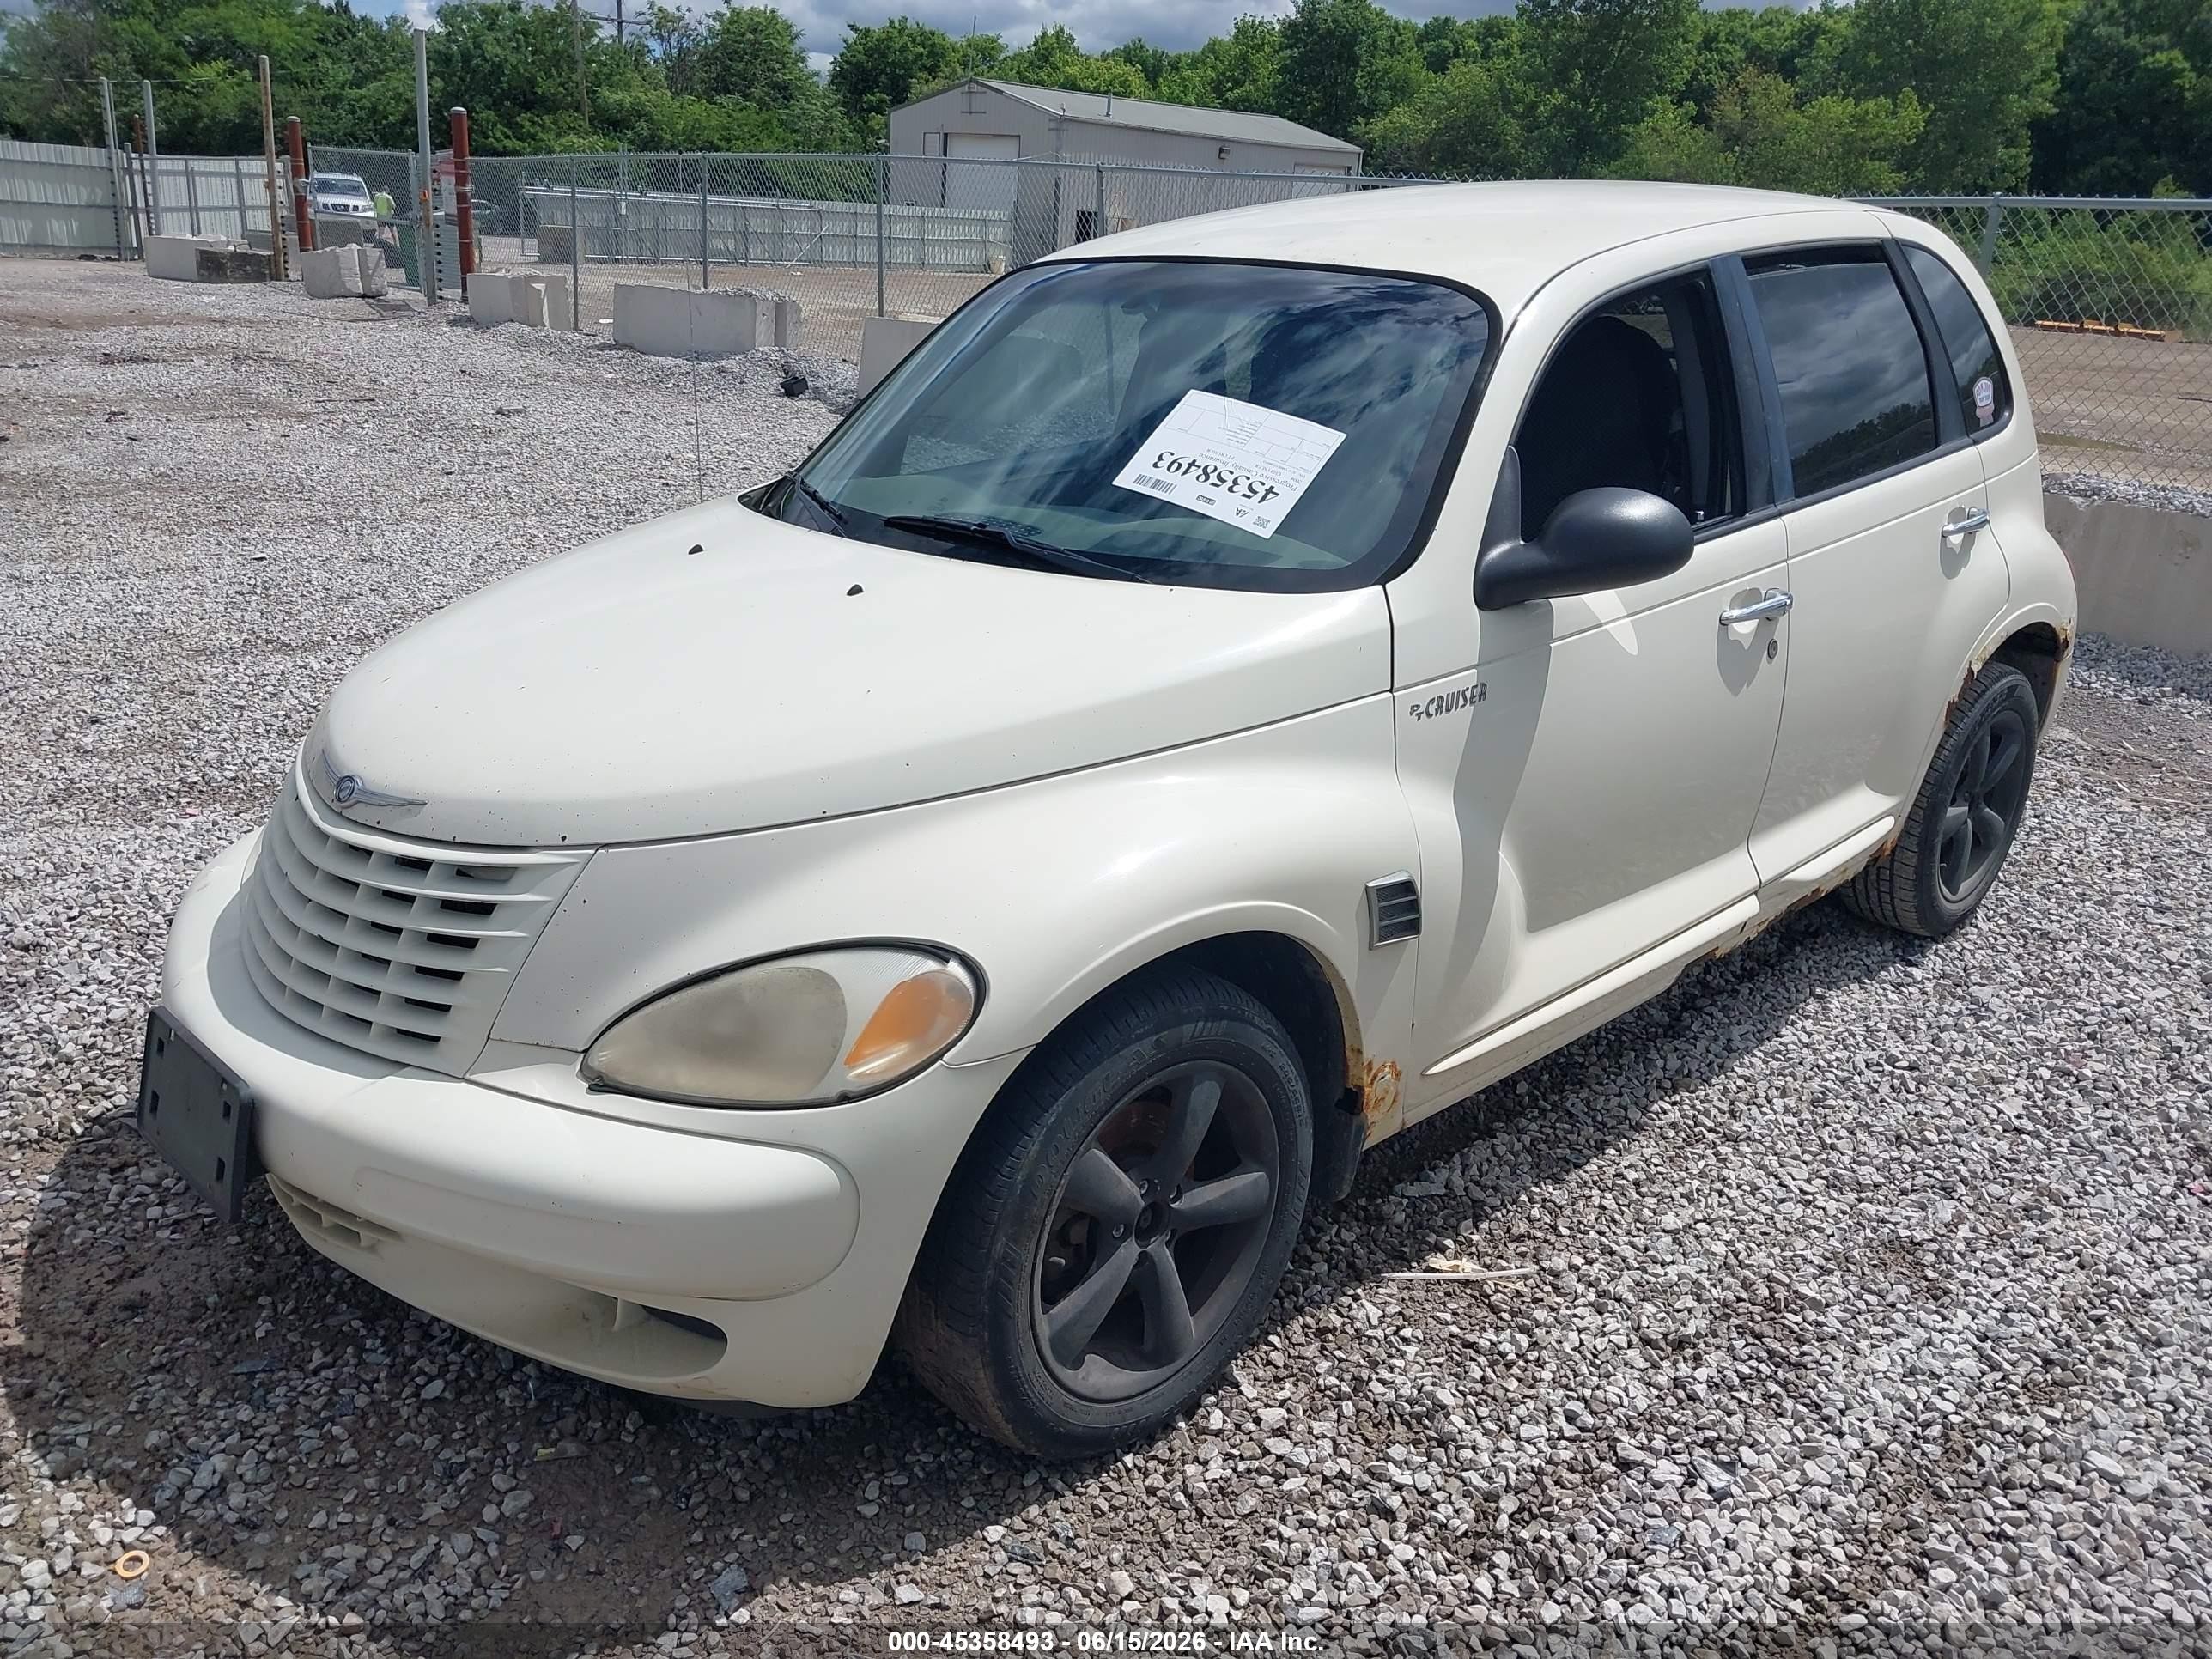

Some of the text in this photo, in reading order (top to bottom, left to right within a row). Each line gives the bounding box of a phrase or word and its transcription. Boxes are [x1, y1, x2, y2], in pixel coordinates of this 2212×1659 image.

[1198, 453, 1229, 468] Insurance
[1230, 462, 1259, 478] Casualty
[1152, 451, 1280, 504] 45358493
[1259, 473, 1297, 492] Progressive
[1425, 682, 1488, 719] CRUISER
